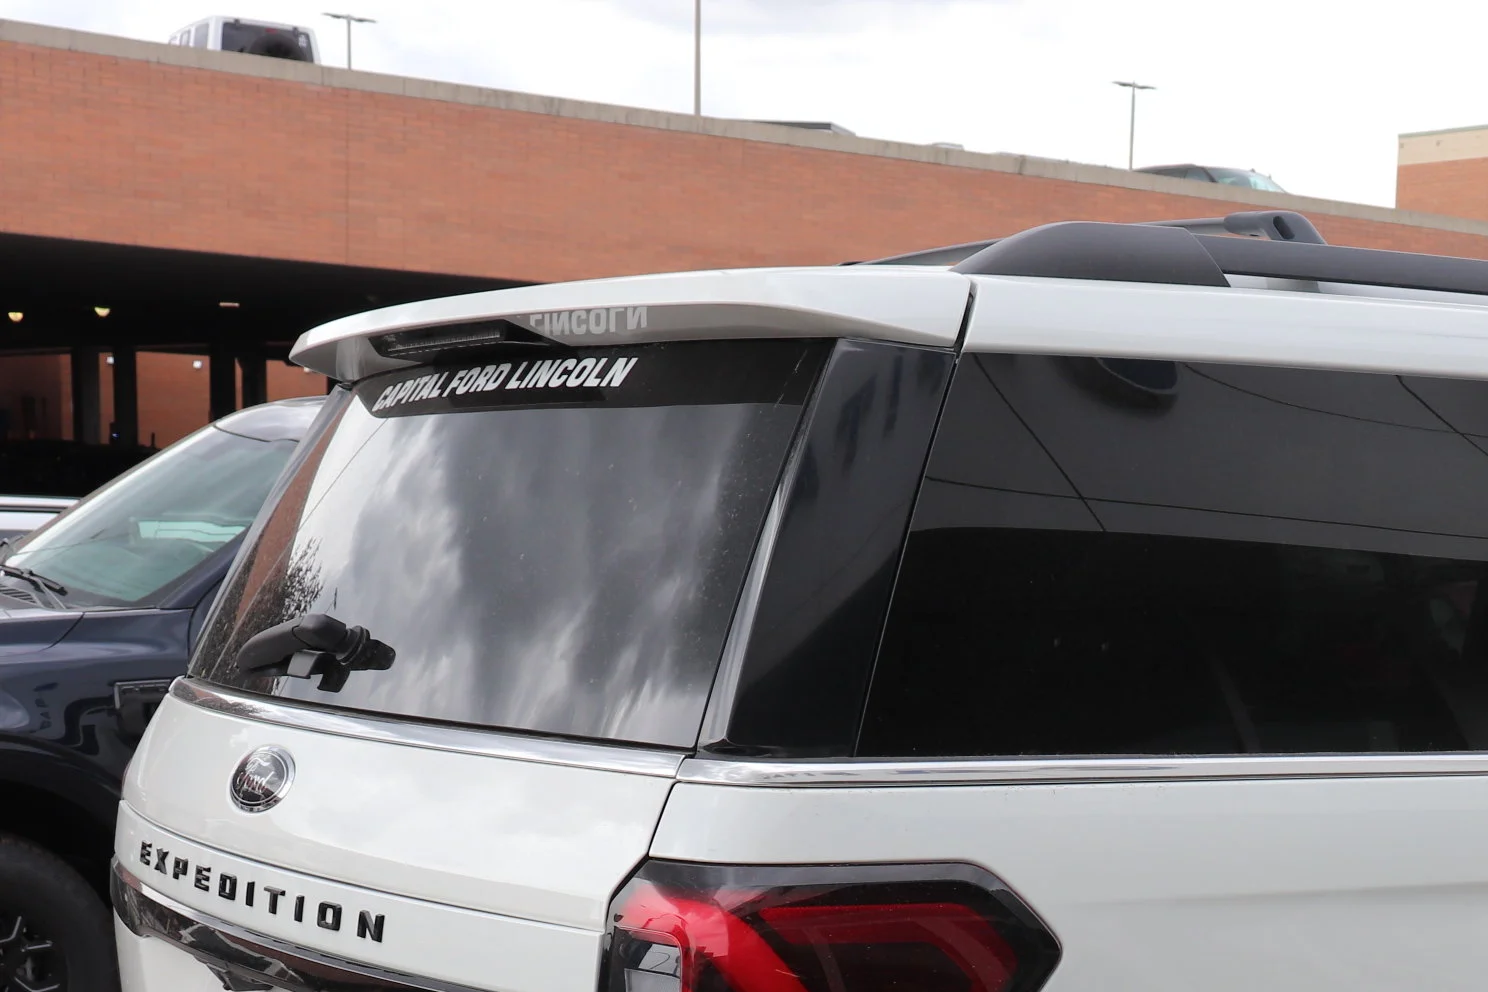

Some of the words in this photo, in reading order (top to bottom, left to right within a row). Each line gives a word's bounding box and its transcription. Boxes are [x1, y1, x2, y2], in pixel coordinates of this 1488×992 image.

[371, 371, 449, 412] CAPITAL
[441, 362, 512, 398] FORD
[504, 357, 639, 390] LINCOLN
[139, 840, 385, 943] EXPEDITION
